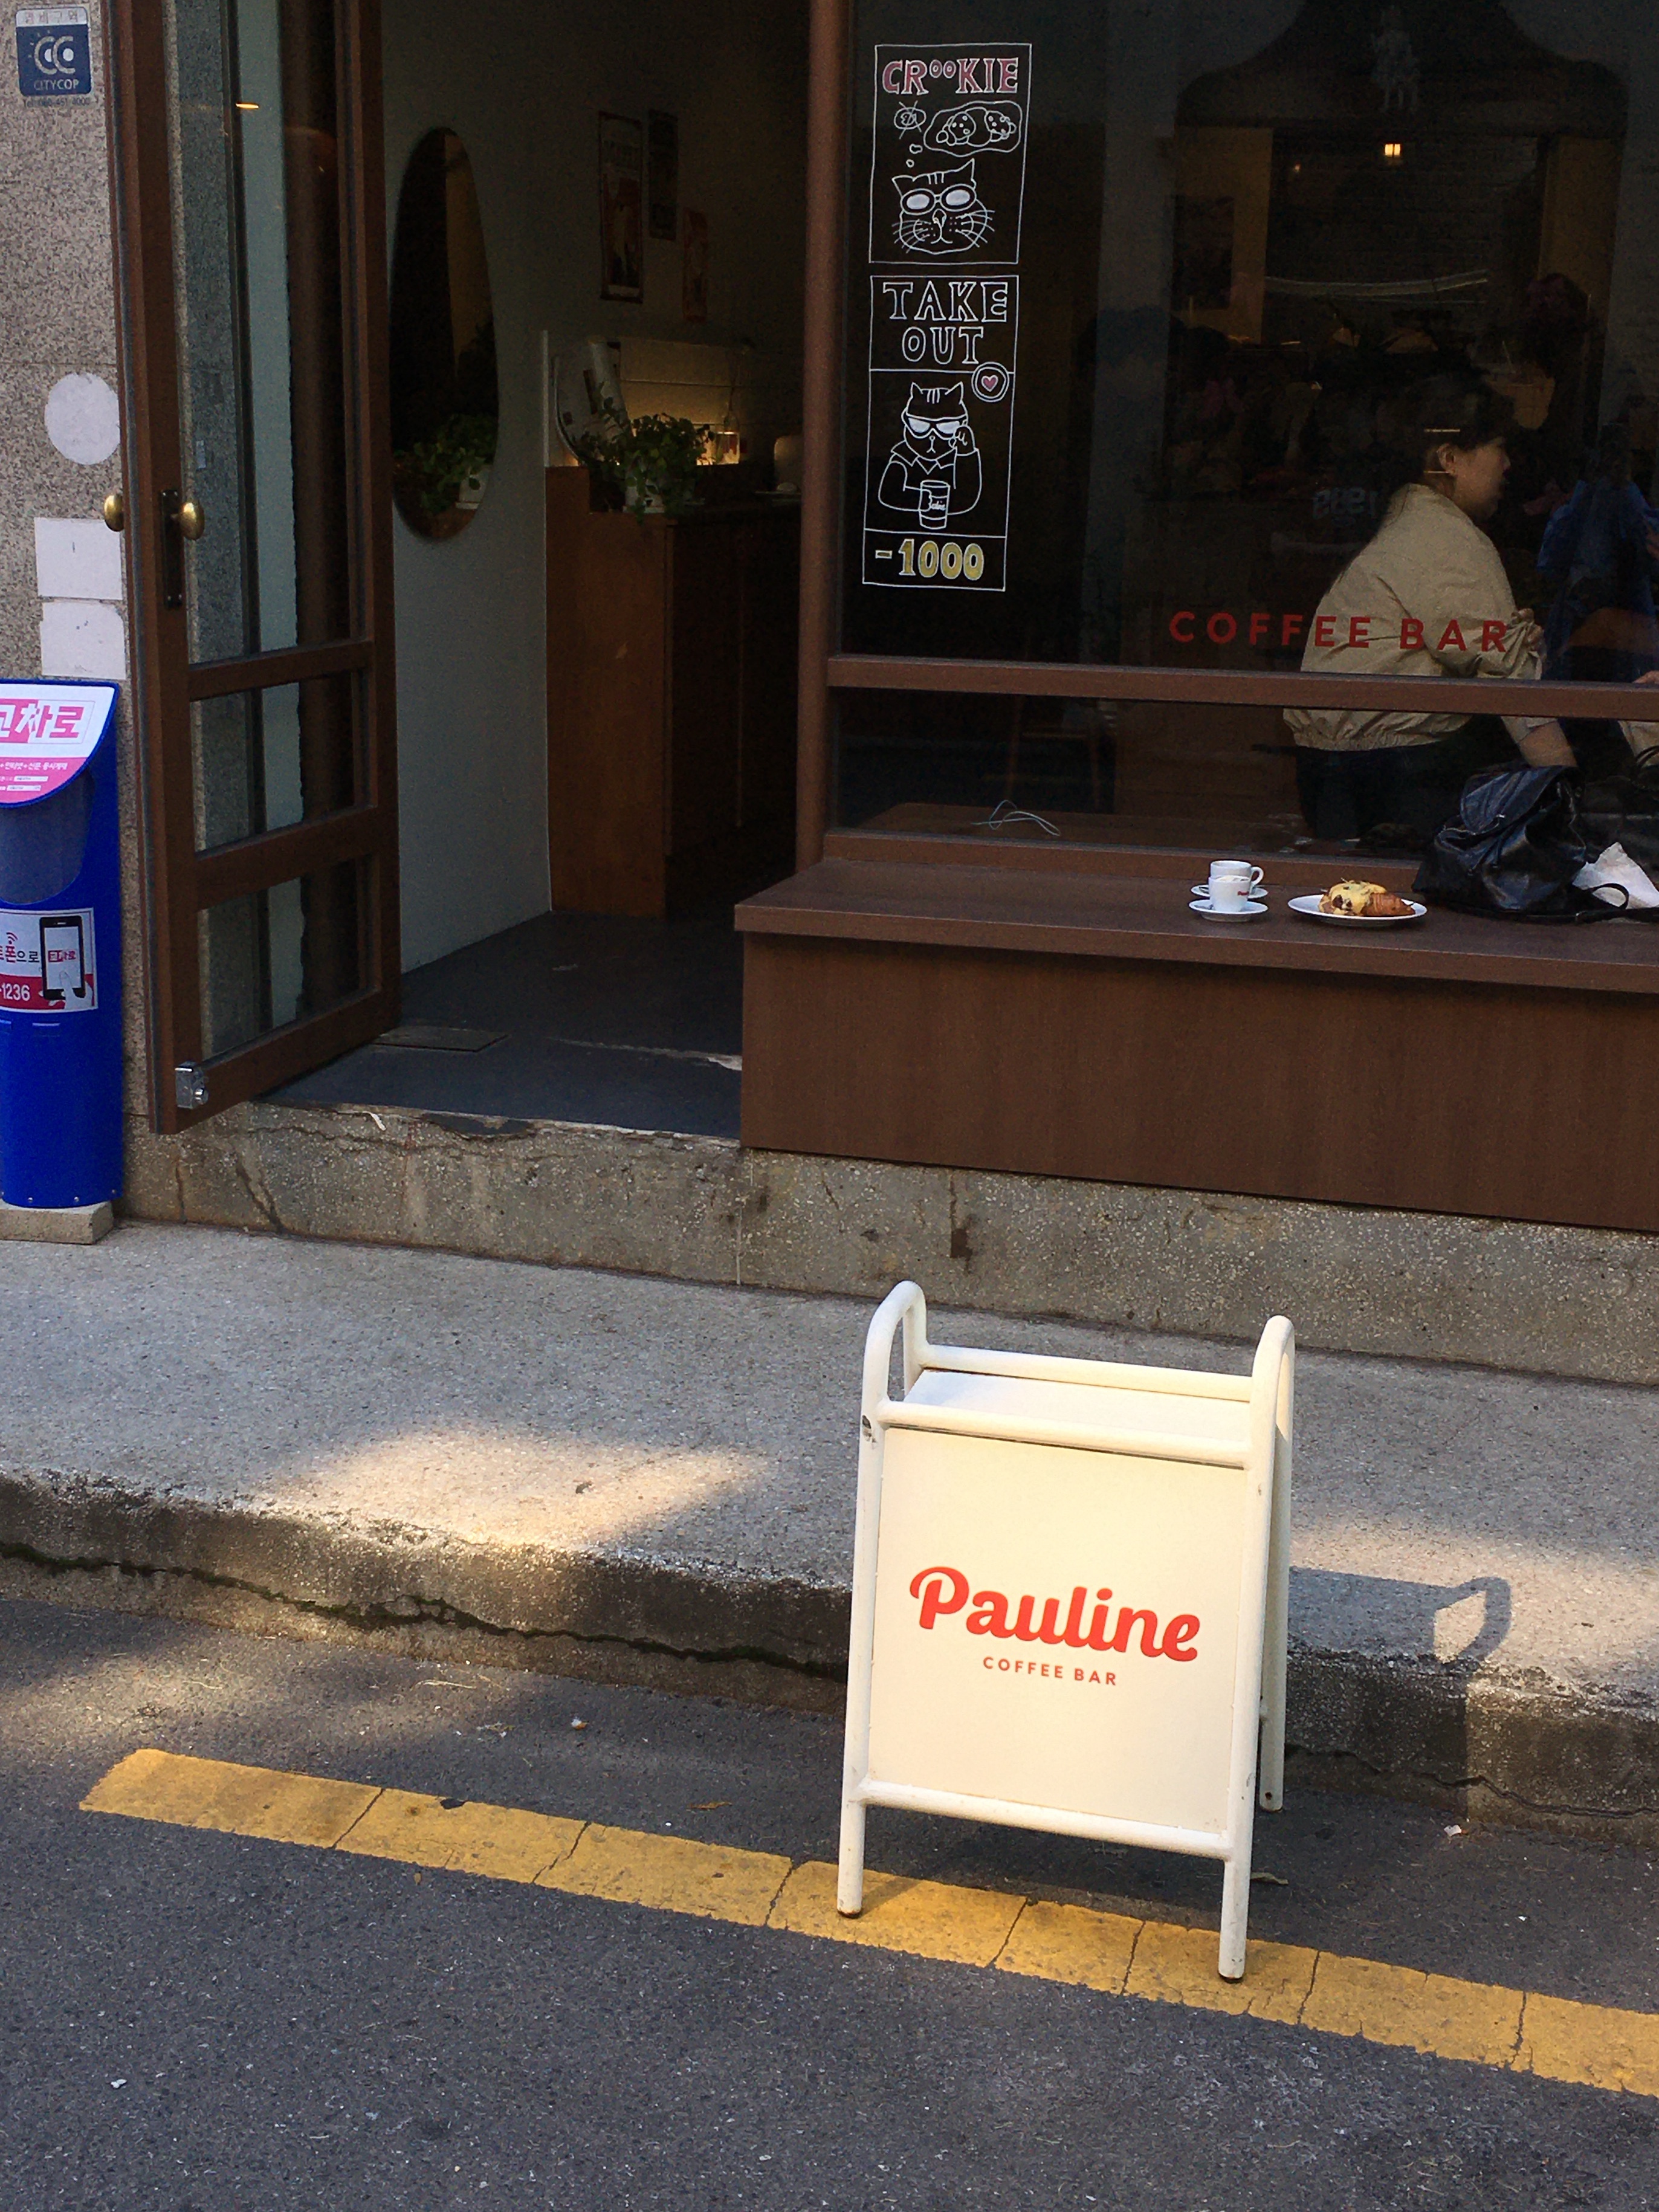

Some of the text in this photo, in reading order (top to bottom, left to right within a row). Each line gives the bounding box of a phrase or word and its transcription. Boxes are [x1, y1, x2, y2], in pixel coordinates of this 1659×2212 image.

[34, 79, 80, 91] CITYCOP
[882, 280, 1008, 322] TAKE
[902, 326, 984, 364] OUT
[875, 538, 985, 581] -1000
[1169, 610, 1509, 653] COFFEE BAR
[909, 1566, 1200, 1662] Pauline
[982, 1656, 1117, 1686] COFFEE BAR
